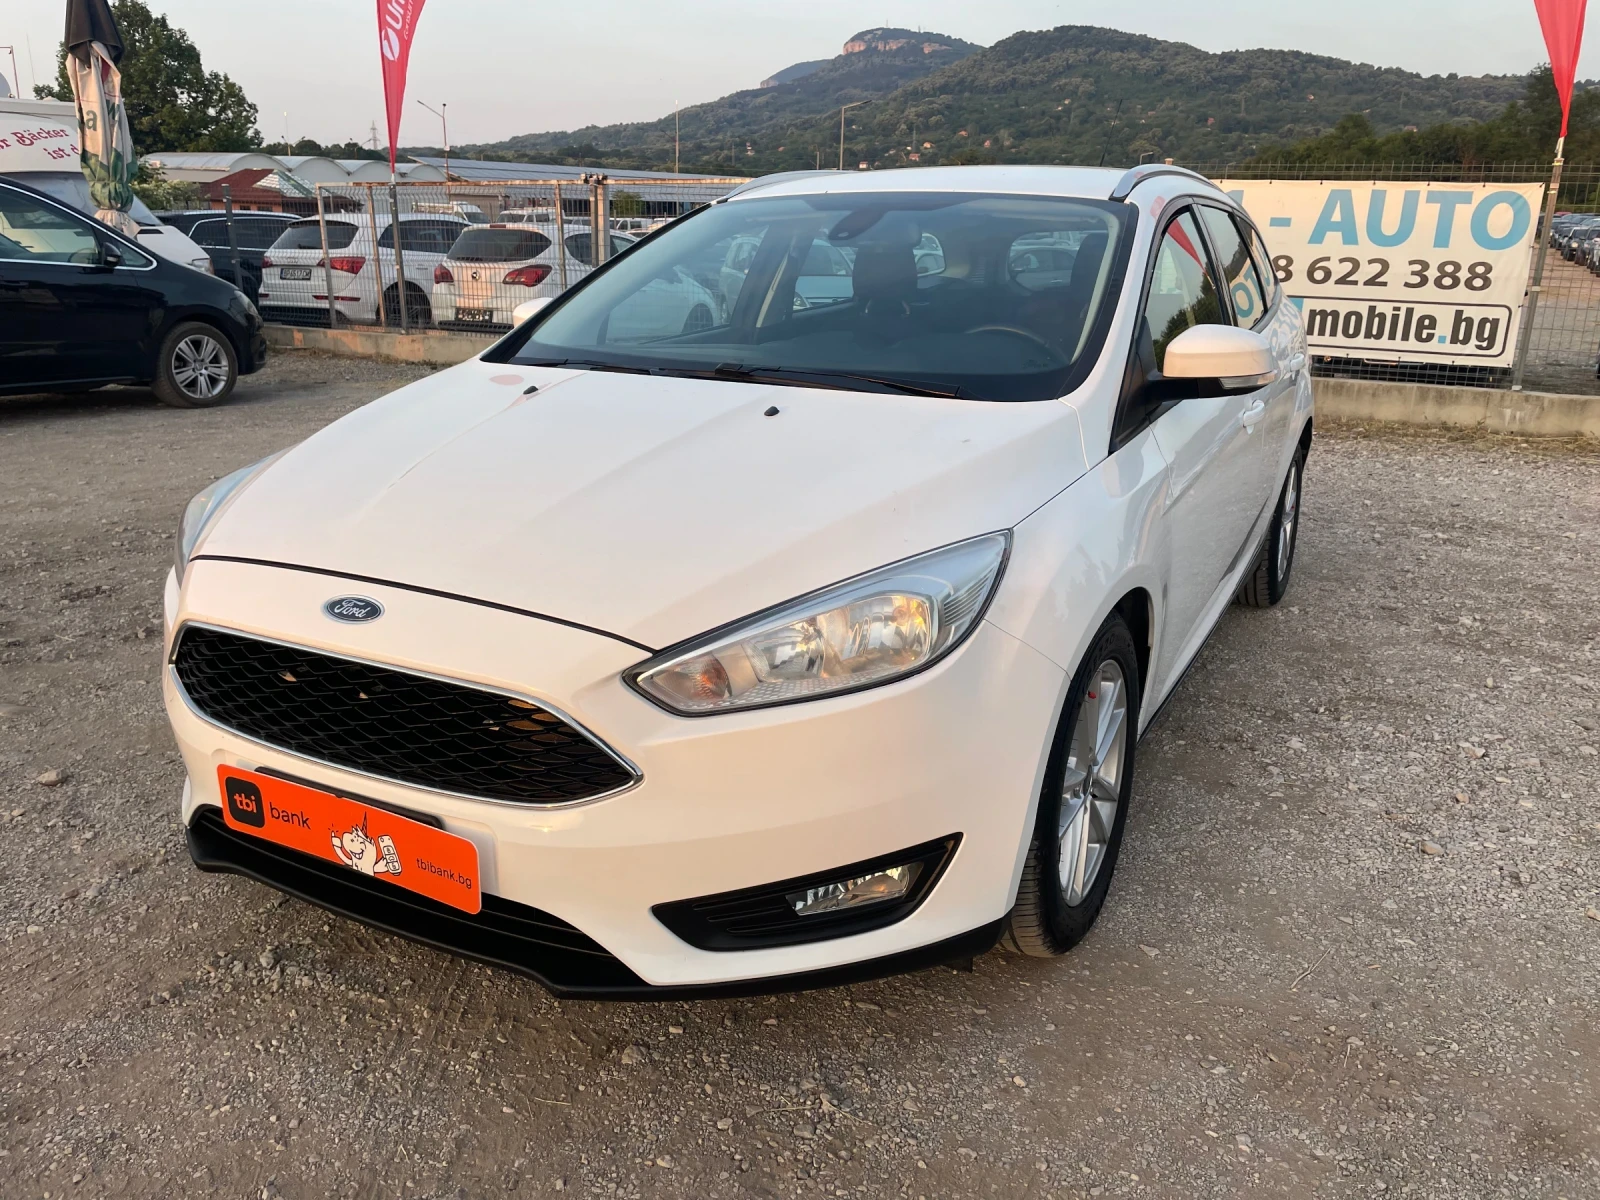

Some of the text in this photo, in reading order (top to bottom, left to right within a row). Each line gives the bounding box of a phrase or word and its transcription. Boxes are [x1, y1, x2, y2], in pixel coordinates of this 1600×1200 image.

[10, 127, 70, 147] Bäcker
[42, 147, 71, 160] ist
[1307, 188, 1532, 251] AUTO
[1306, 256, 1390, 287] 622
[1403, 259, 1493, 292] 388
[1306, 305, 1501, 351] mobile.bg
[334, 599, 372, 618] Ford
[233, 793, 311, 830] tbi bank
[416, 858, 472, 889] tbibank.bg
